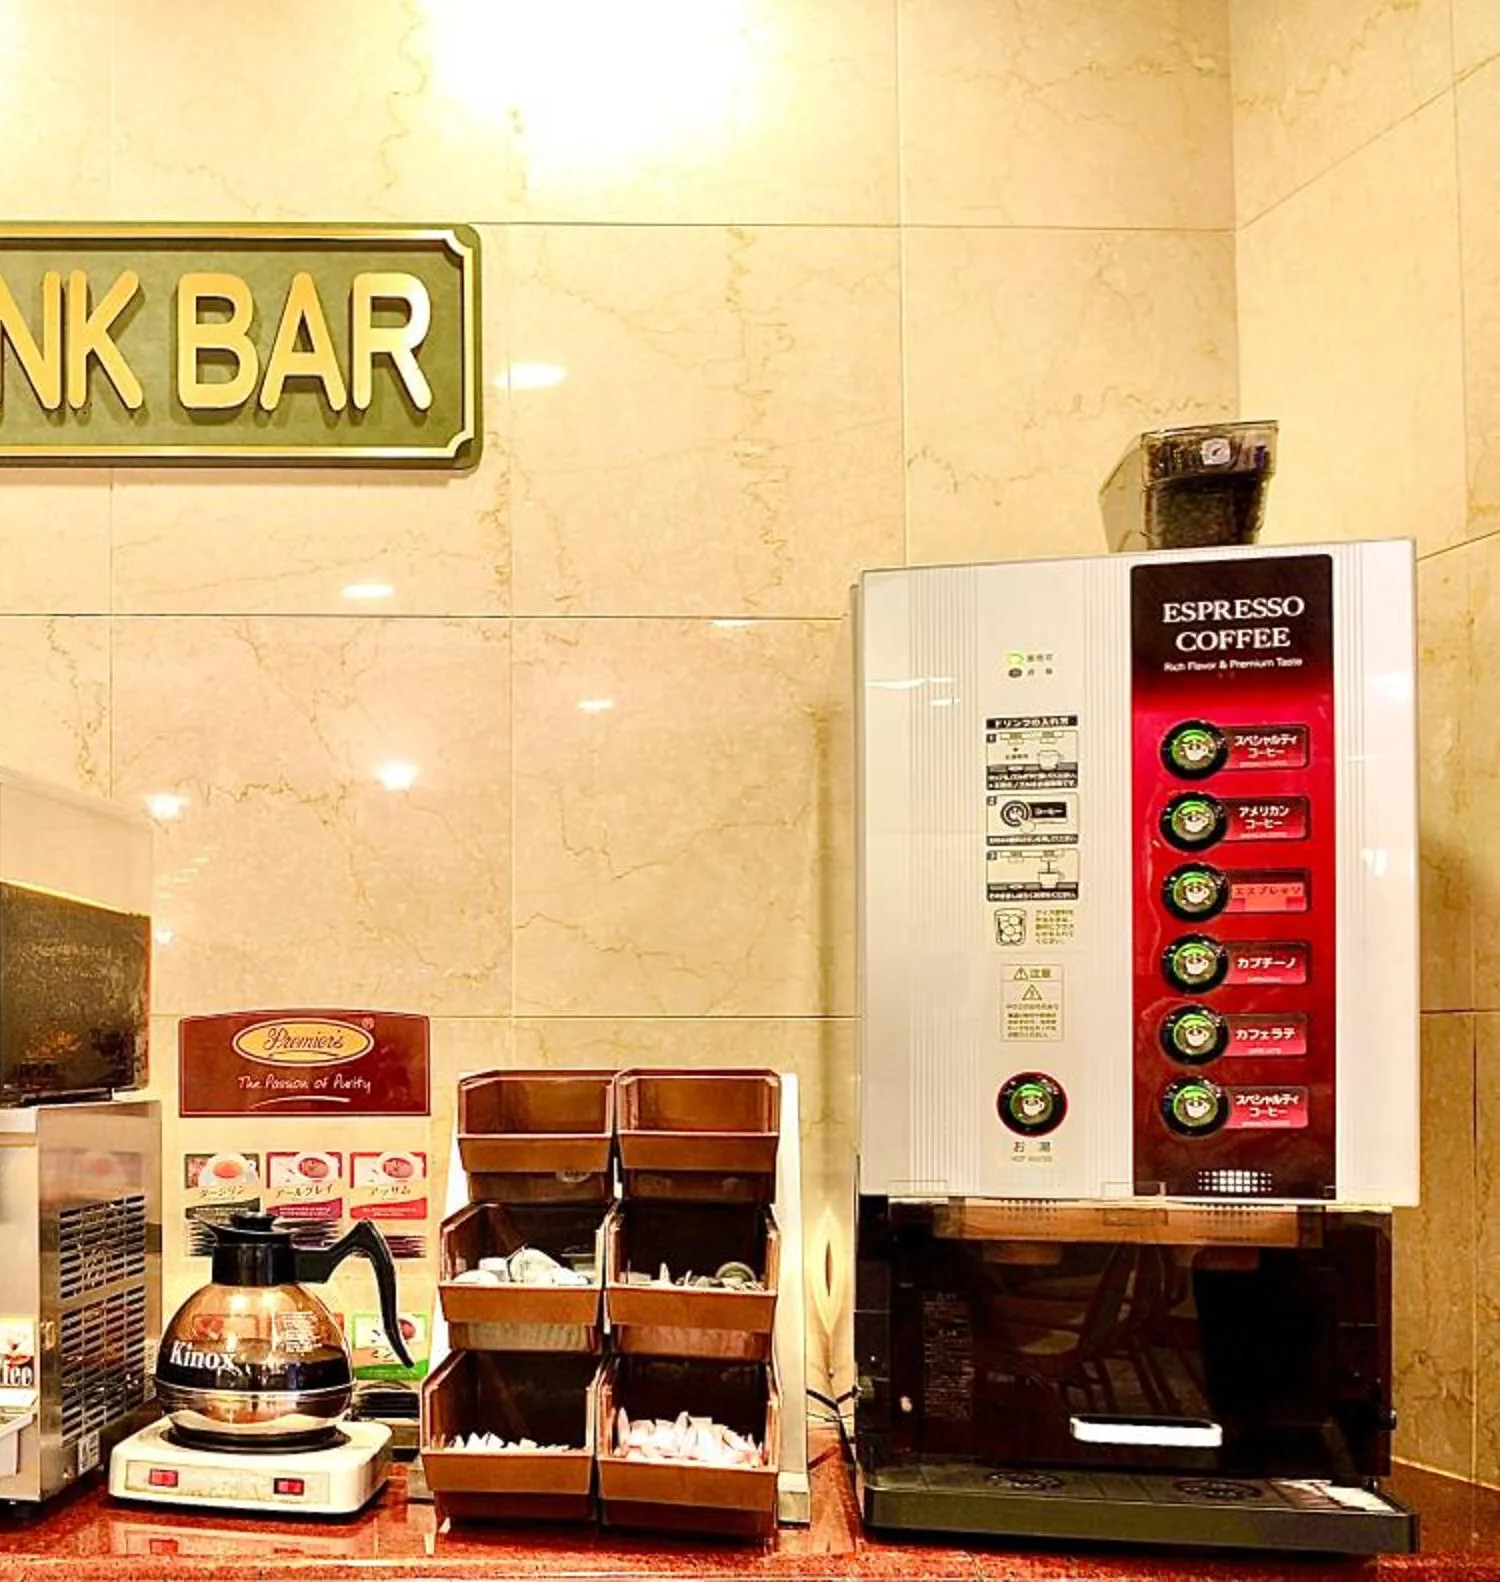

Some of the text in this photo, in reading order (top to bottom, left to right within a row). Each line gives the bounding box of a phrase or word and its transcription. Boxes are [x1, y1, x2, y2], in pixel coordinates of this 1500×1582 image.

[177, 270, 433, 412] BAR
[1162, 595, 1306, 623] ESPRESSO
[1175, 626, 1291, 651] COFFEE
[1163, 661, 1186, 672] Rich
[1187, 660, 1217, 671] Flavor
[1229, 658, 1275, 669] Premium
[1275, 656, 1303, 667] Taste
[1247, 747, 1285, 759] コーヒー
[1239, 805, 1290, 817] アメリカン
[1244, 819, 1284, 830] コーヒー
[1237, 957, 1296, 969] カプチーノ
[263, 1027, 345, 1051] Premier's
[1235, 1027, 1296, 1040] カフェラテ
[238, 1073, 371, 1093] The Passion of Purity
[1249, 1107, 1288, 1118] コーヒー
[169, 1340, 238, 1372] Kinox
